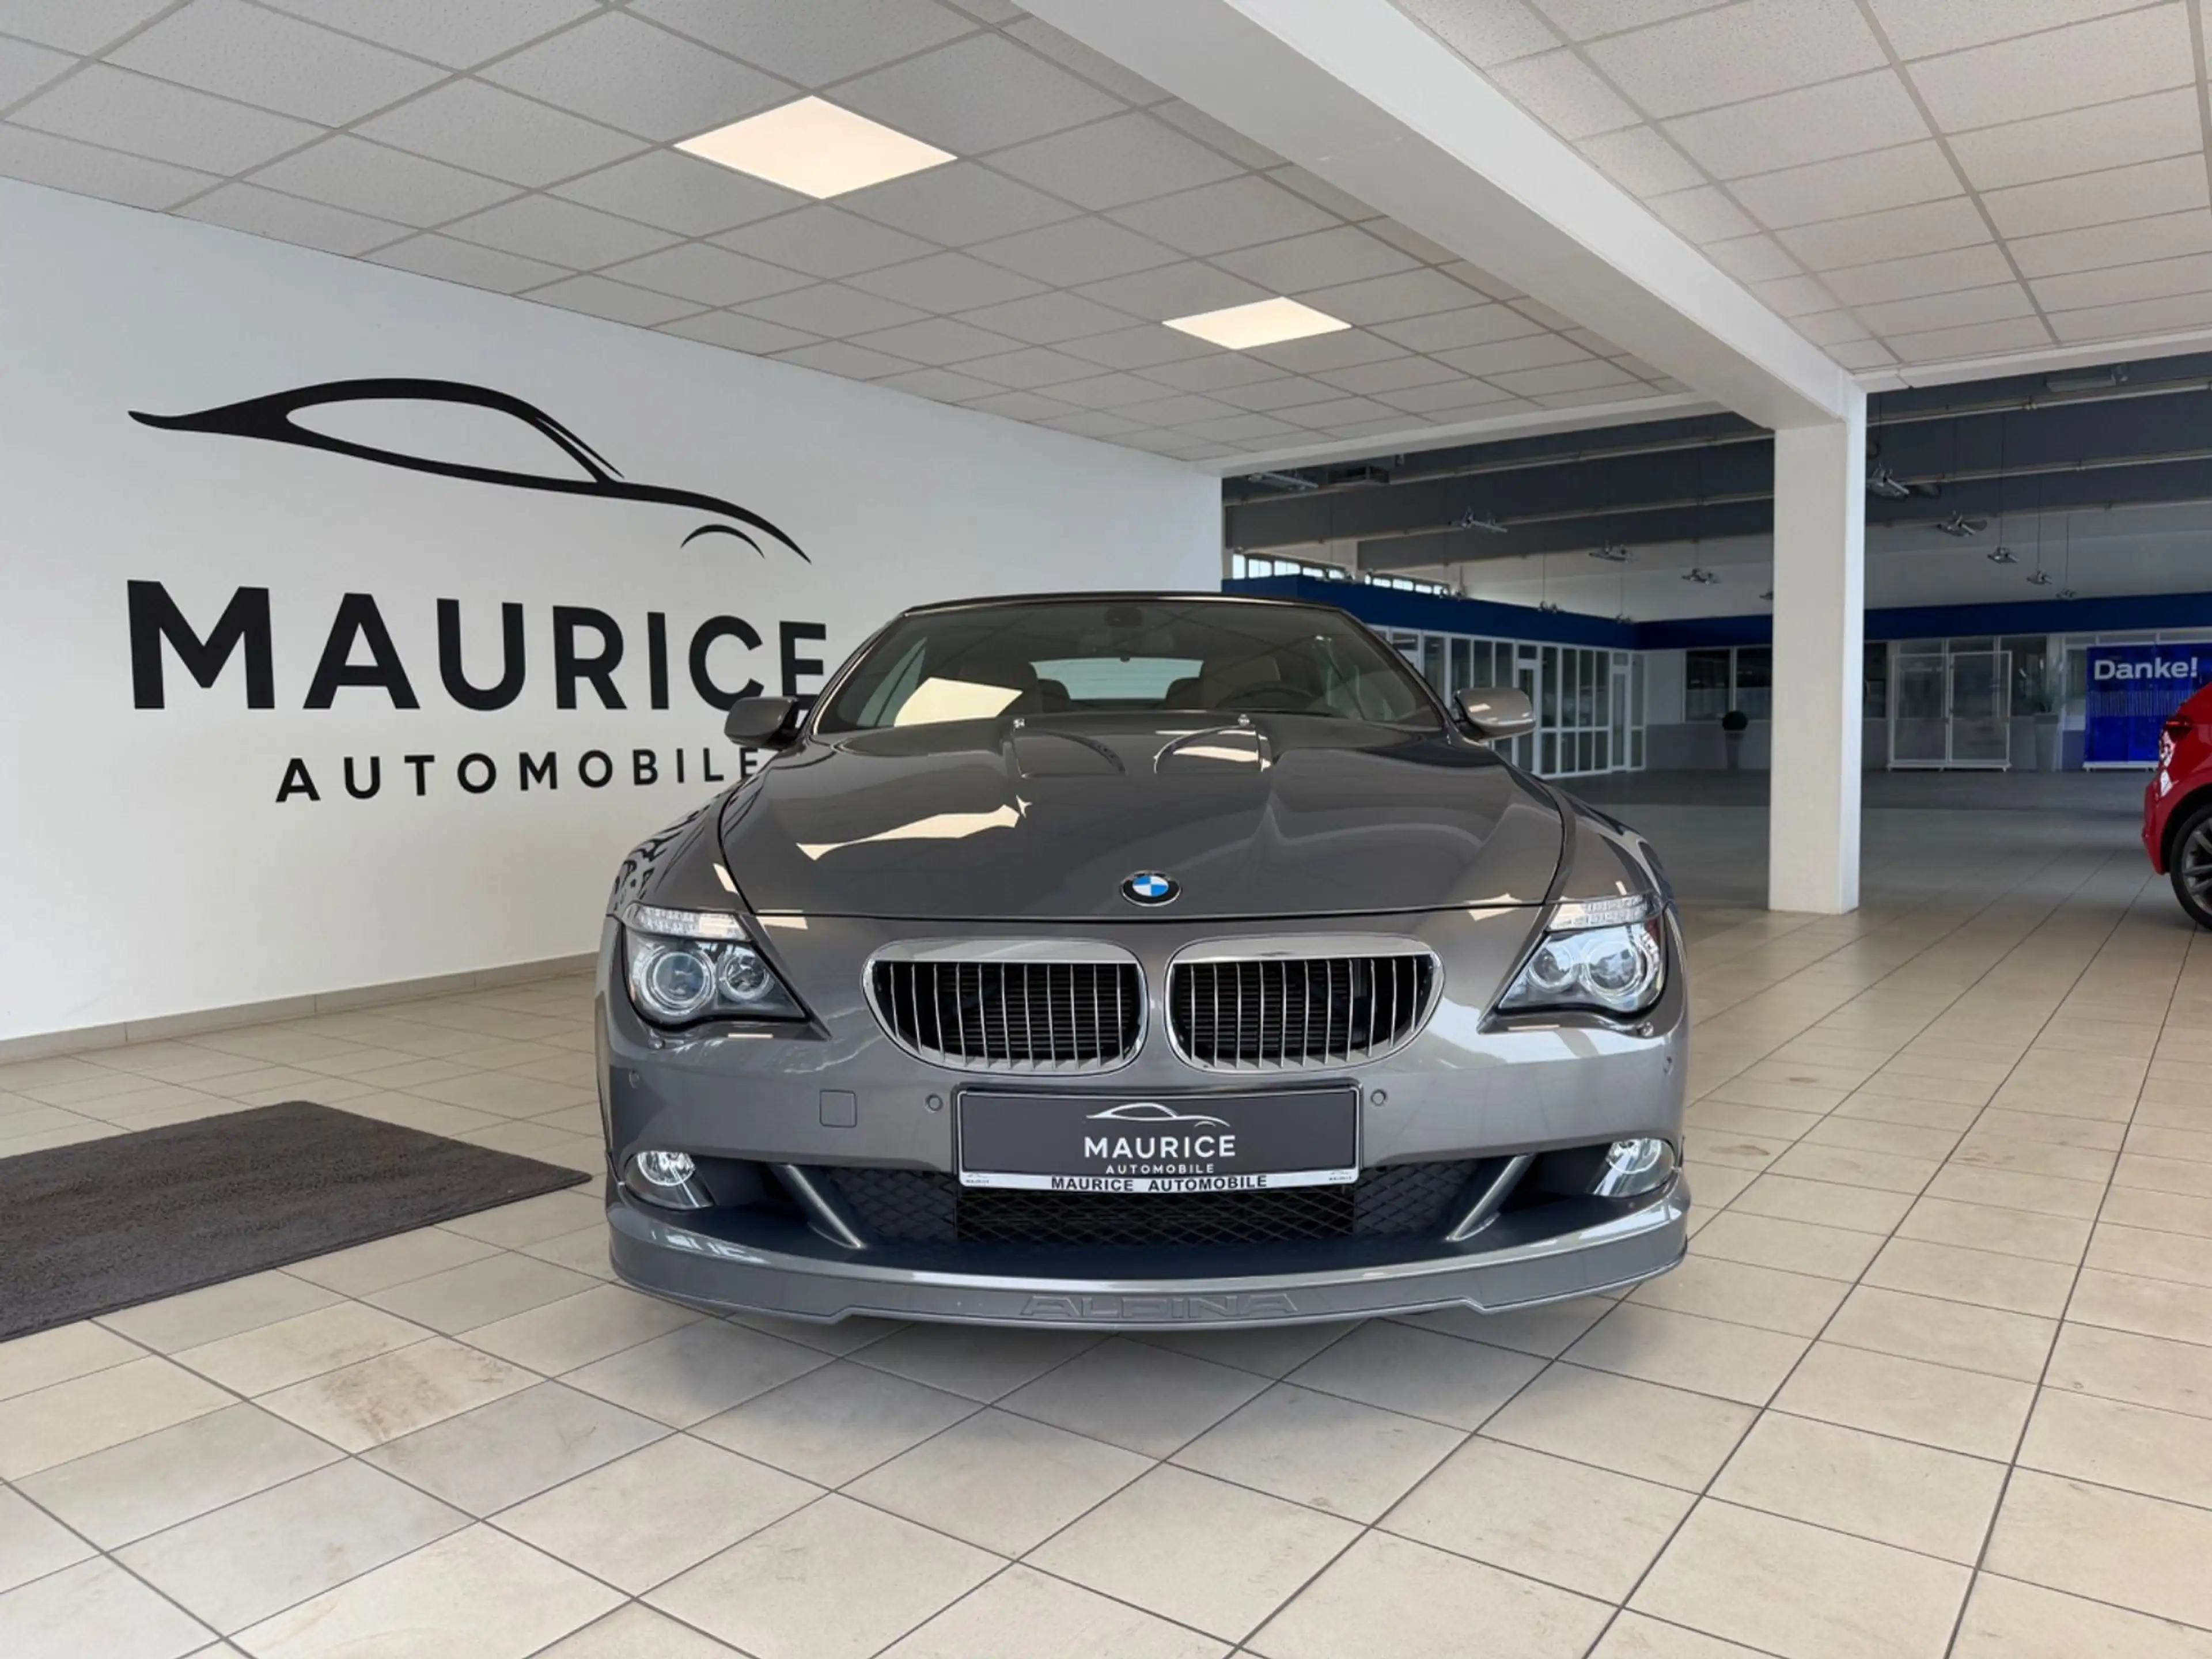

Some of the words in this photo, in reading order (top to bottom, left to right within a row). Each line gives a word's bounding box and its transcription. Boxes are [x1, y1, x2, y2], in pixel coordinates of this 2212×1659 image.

[127, 580, 827, 711] MAURICE
[2094, 657, 2198, 680] Danke!
[276, 746, 759, 802] AUTOMOBILE
[1084, 1135, 1236, 1159] MAURICE
[1105, 1164, 1214, 1175] AUTOMOBILE
[1051, 1177, 1133, 1192] MAURICE
[1148, 1175, 1267, 1192] AUTOMOBILE
[1019, 1293, 1298, 1319] ALPINA
